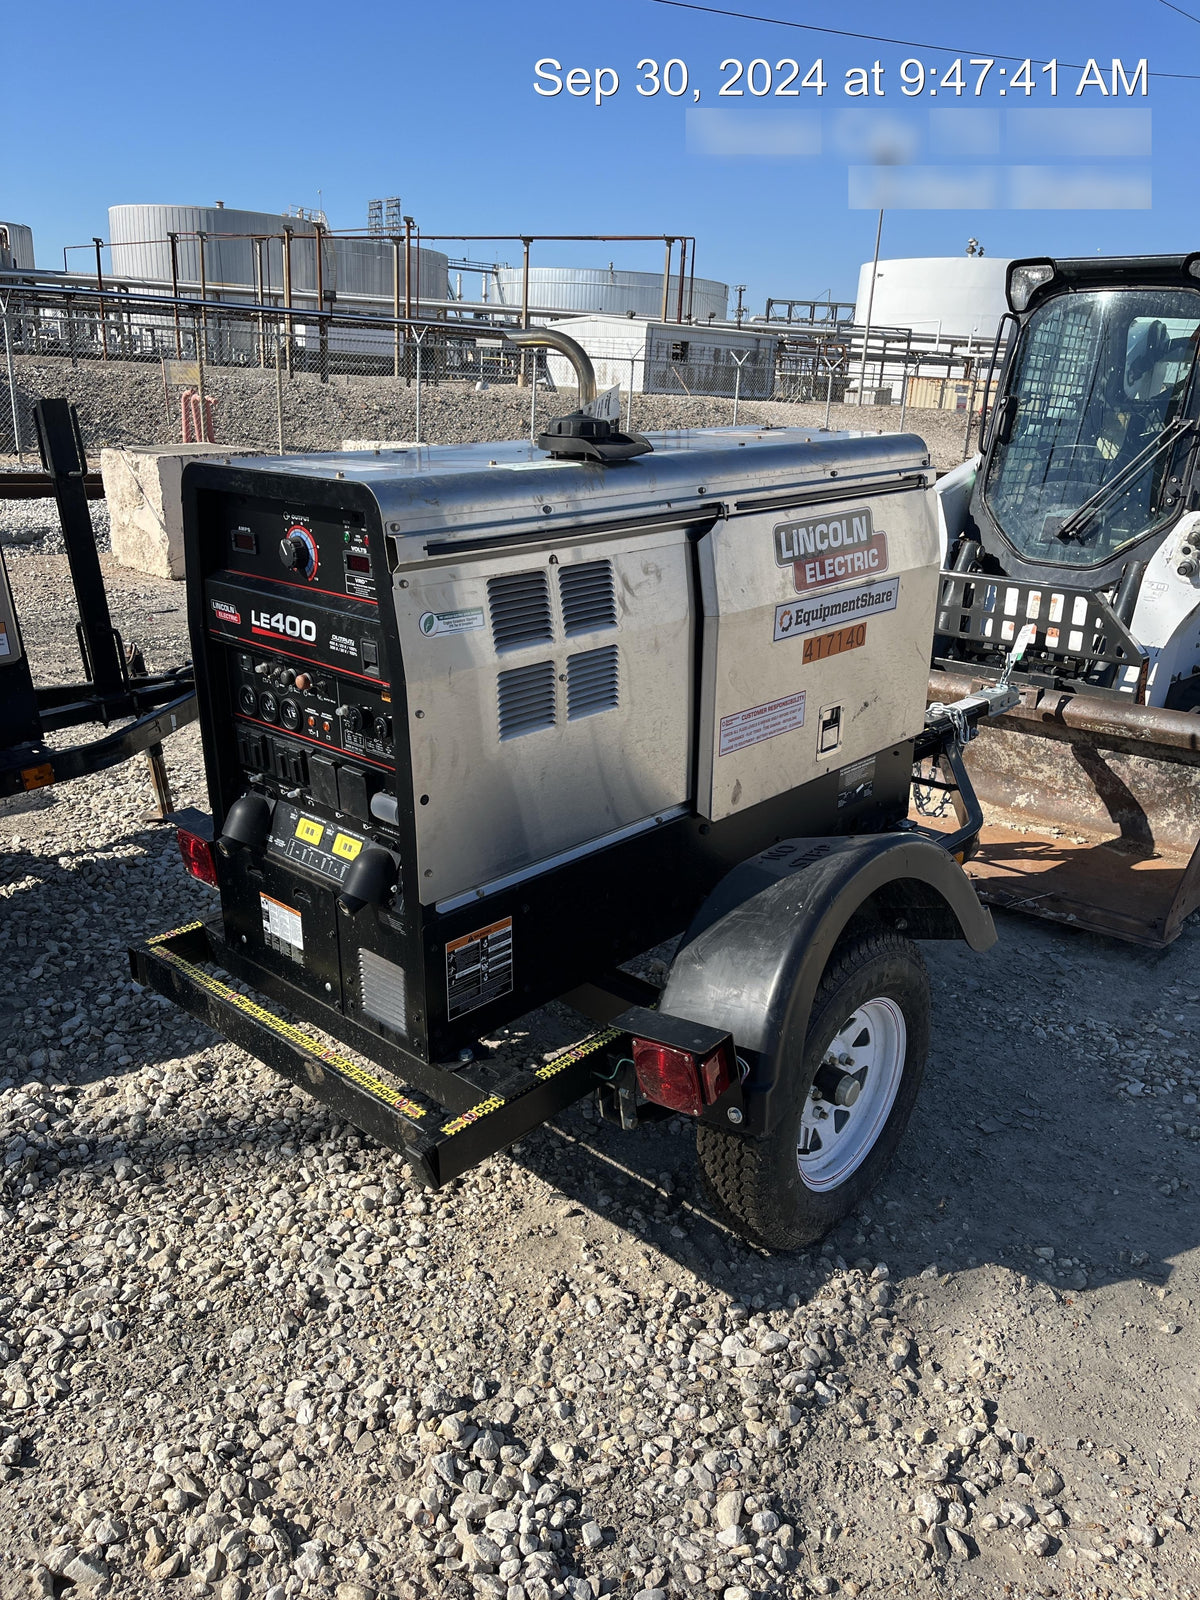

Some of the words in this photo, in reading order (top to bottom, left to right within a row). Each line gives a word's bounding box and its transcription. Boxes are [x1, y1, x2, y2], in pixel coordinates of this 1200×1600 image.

[350, 545, 367, 554] VOLTS
[780, 515, 868, 559] LINCOLN
[805, 548, 879, 584] ELECTRIC
[212, 601, 235, 614] LINCOLN
[218, 610, 239, 622] ELECTRIC
[794, 588, 893, 627] EquipmentShare
[251, 609, 317, 642] LE400
[804, 623, 866, 662] 417140
[741, 707, 767, 721] CUSTOMER
[767, 695, 805, 712] RESPONSIBILITY
[192, 969, 213, 987] STAND
[211, 983, 231, 996] HERE
[235, 997, 247, 1006] NE
[245, 1004, 261, 1015] PAS
[260, 1013, 284, 1029] TENEZ
[281, 1026, 314, 1046] DEBOUT
[311, 1044, 324, 1053] ICI
[331, 1057, 345, 1066] NO
[343, 1064, 357, 1074] SE
[354, 1072, 377, 1088] PARE
[375, 1086, 398, 1101] AQUI
[549, 1056, 573, 1072] HERE
[476, 1103, 493, 1114] DO
